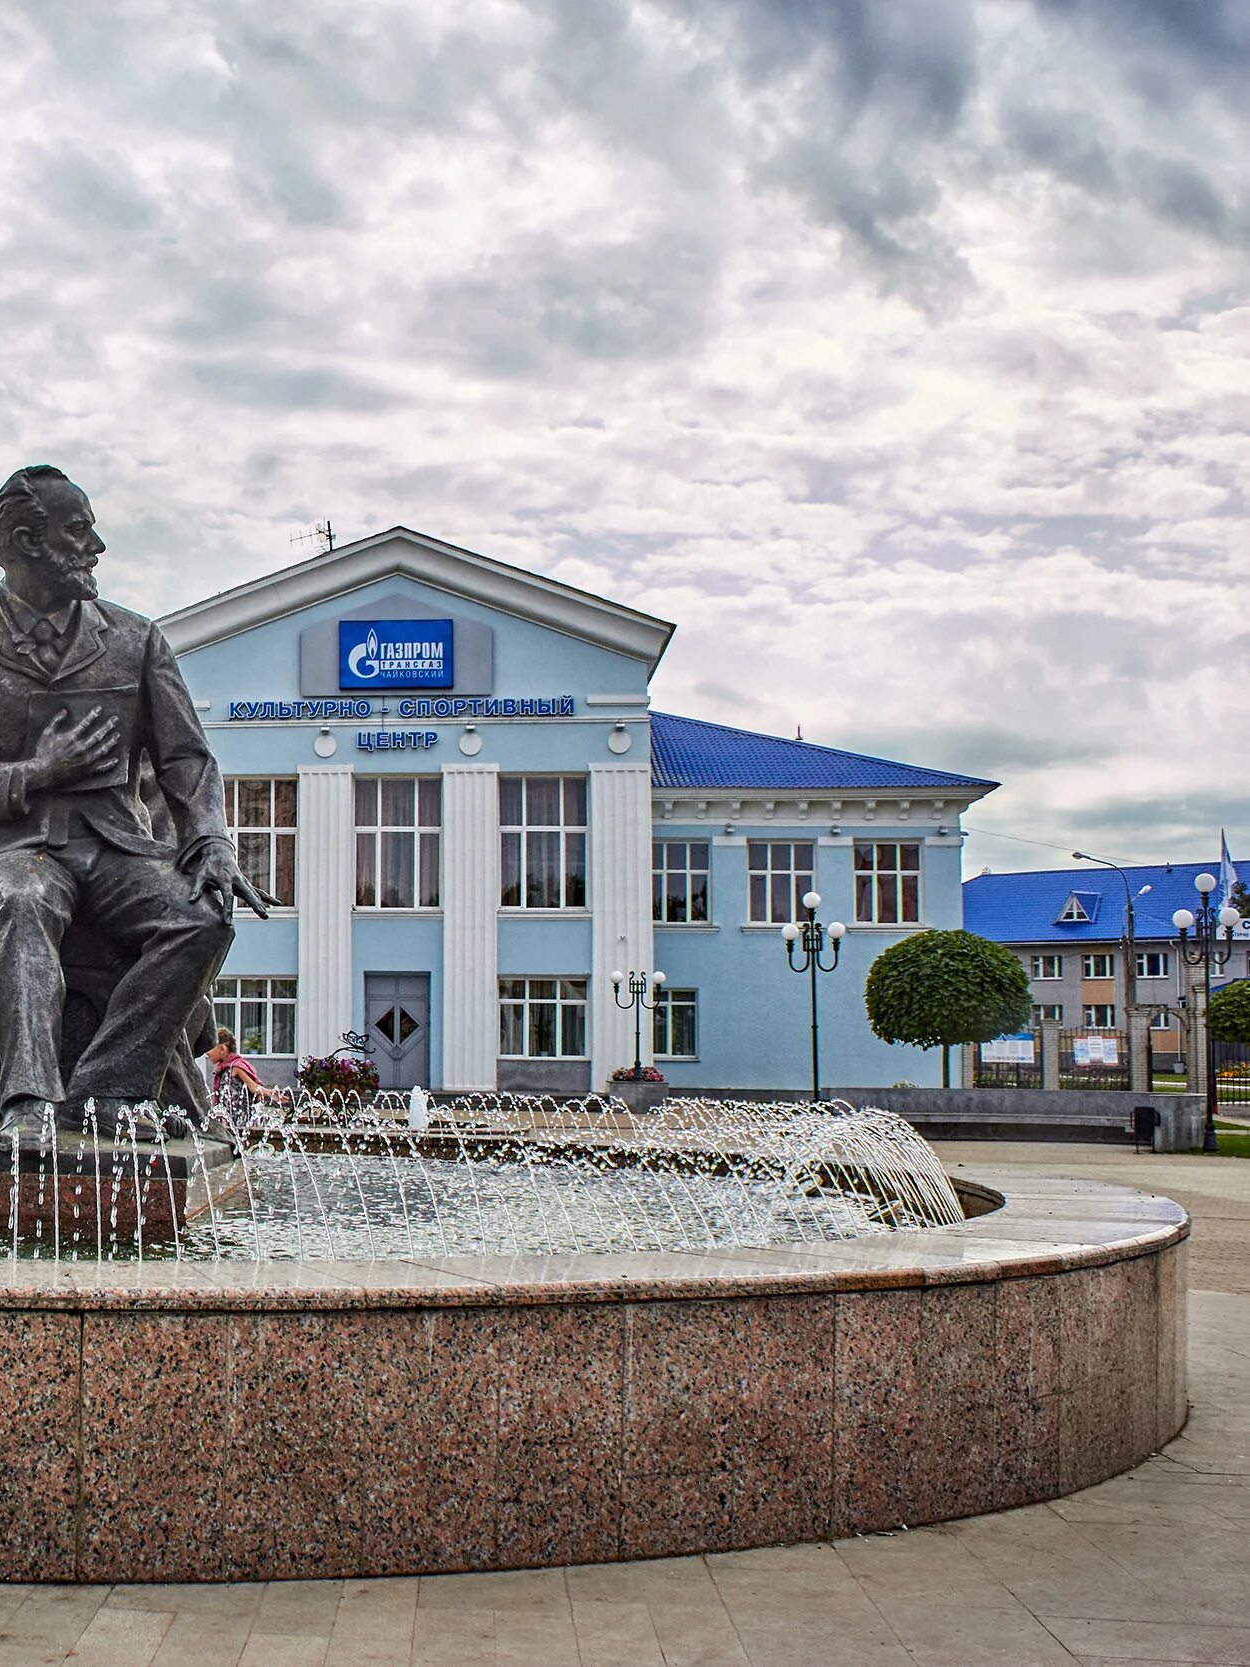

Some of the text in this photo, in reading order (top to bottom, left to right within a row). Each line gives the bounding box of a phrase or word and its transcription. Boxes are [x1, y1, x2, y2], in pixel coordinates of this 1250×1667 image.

[380, 642, 444, 659] ГАЗПРОМ
[381, 660, 443, 669] ТРАНСГАЗ
[380, 669, 444, 678] ЧАЙКОВСКИЙ
[228, 699, 372, 719] КУЛЬТУРНО
[398, 695, 575, 718] СПОРТИВНЫЙ
[356, 731, 438, 752] ЦЕНТР
